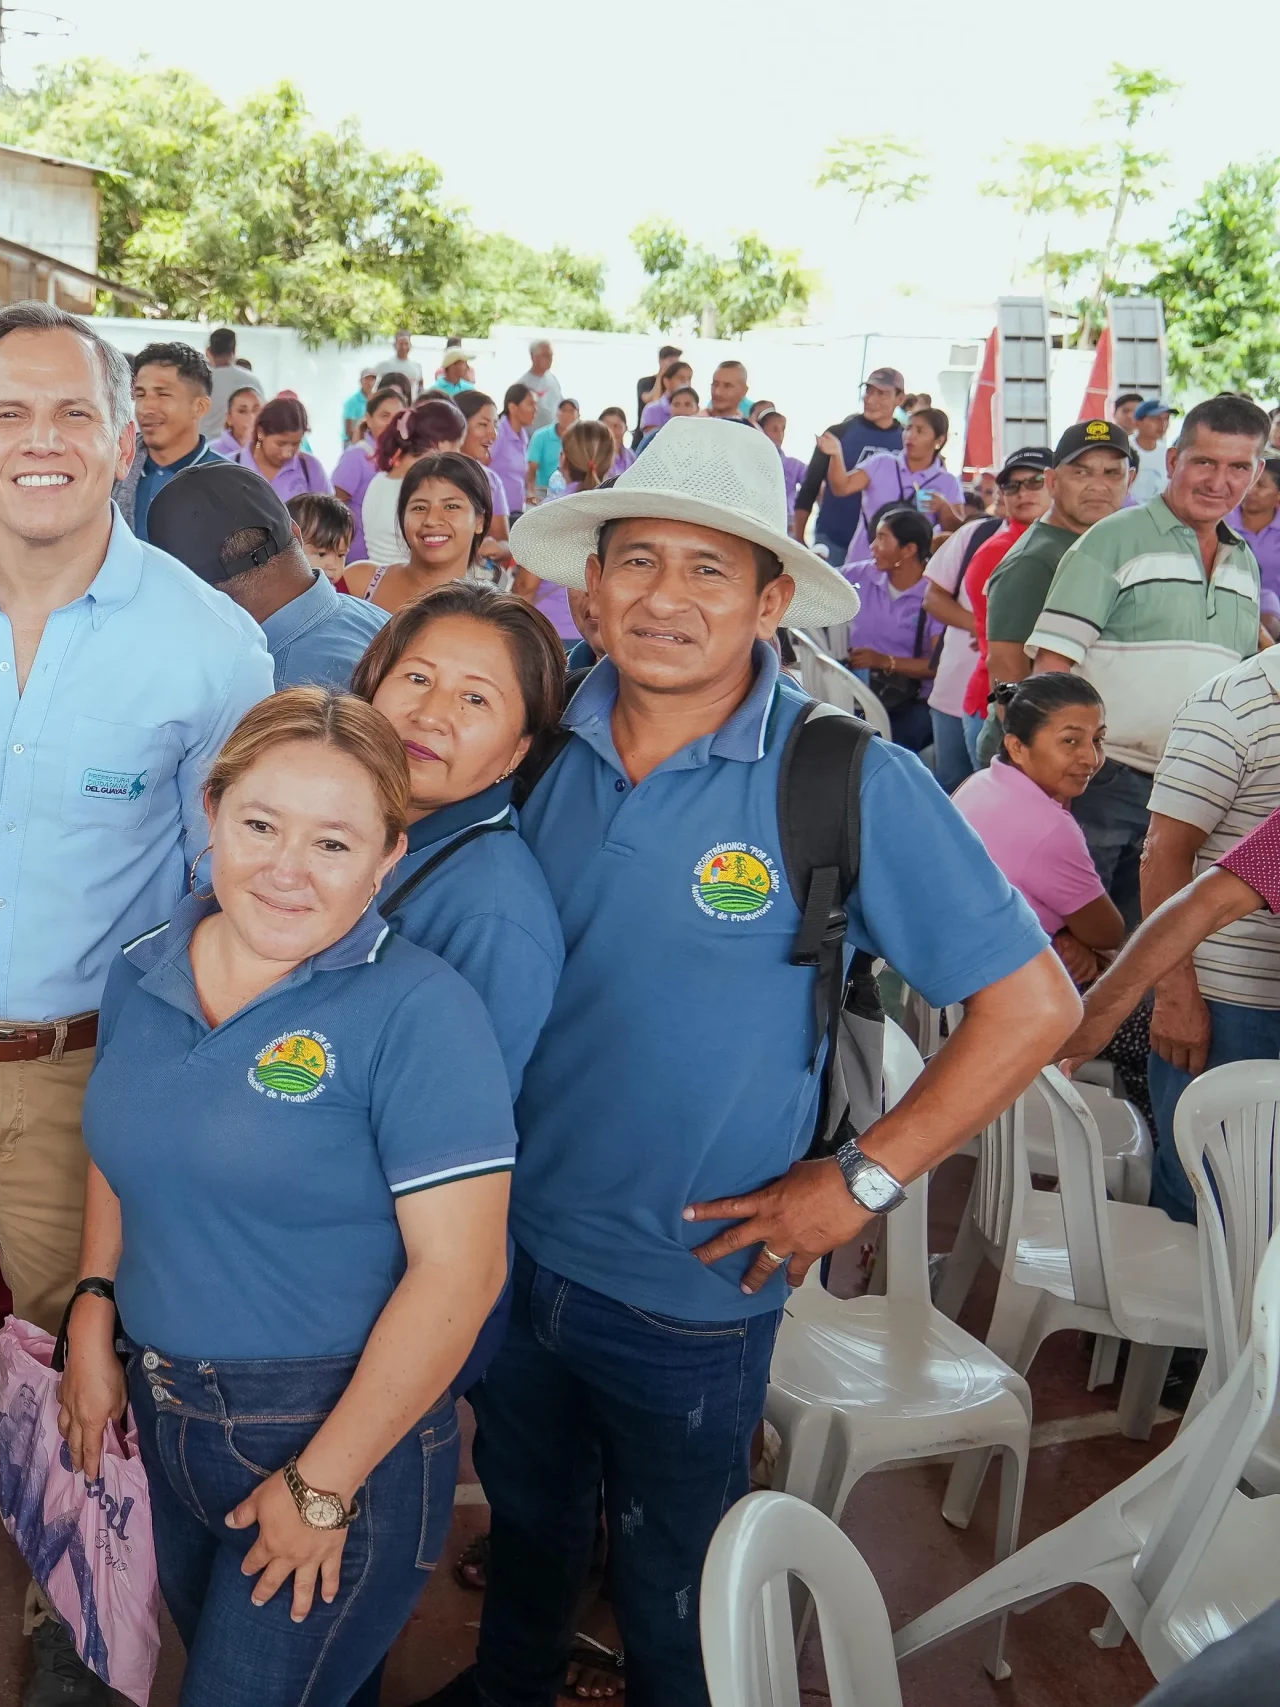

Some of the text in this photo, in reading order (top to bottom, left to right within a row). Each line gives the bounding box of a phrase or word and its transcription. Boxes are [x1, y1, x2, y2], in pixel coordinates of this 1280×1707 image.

[88, 772, 130, 784] PREFECTURA
[85, 784, 127, 795] DEL GUAYAS
[693, 841, 747, 876] ENCONTRÉMONOS
[763, 858, 774, 869] EL
[716, 911, 728, 921] de
[730, 899, 775, 922] Productores
[322, 1042, 332, 1052] EL
[266, 1088, 278, 1099] de
[280, 1082, 326, 1103] Productores
